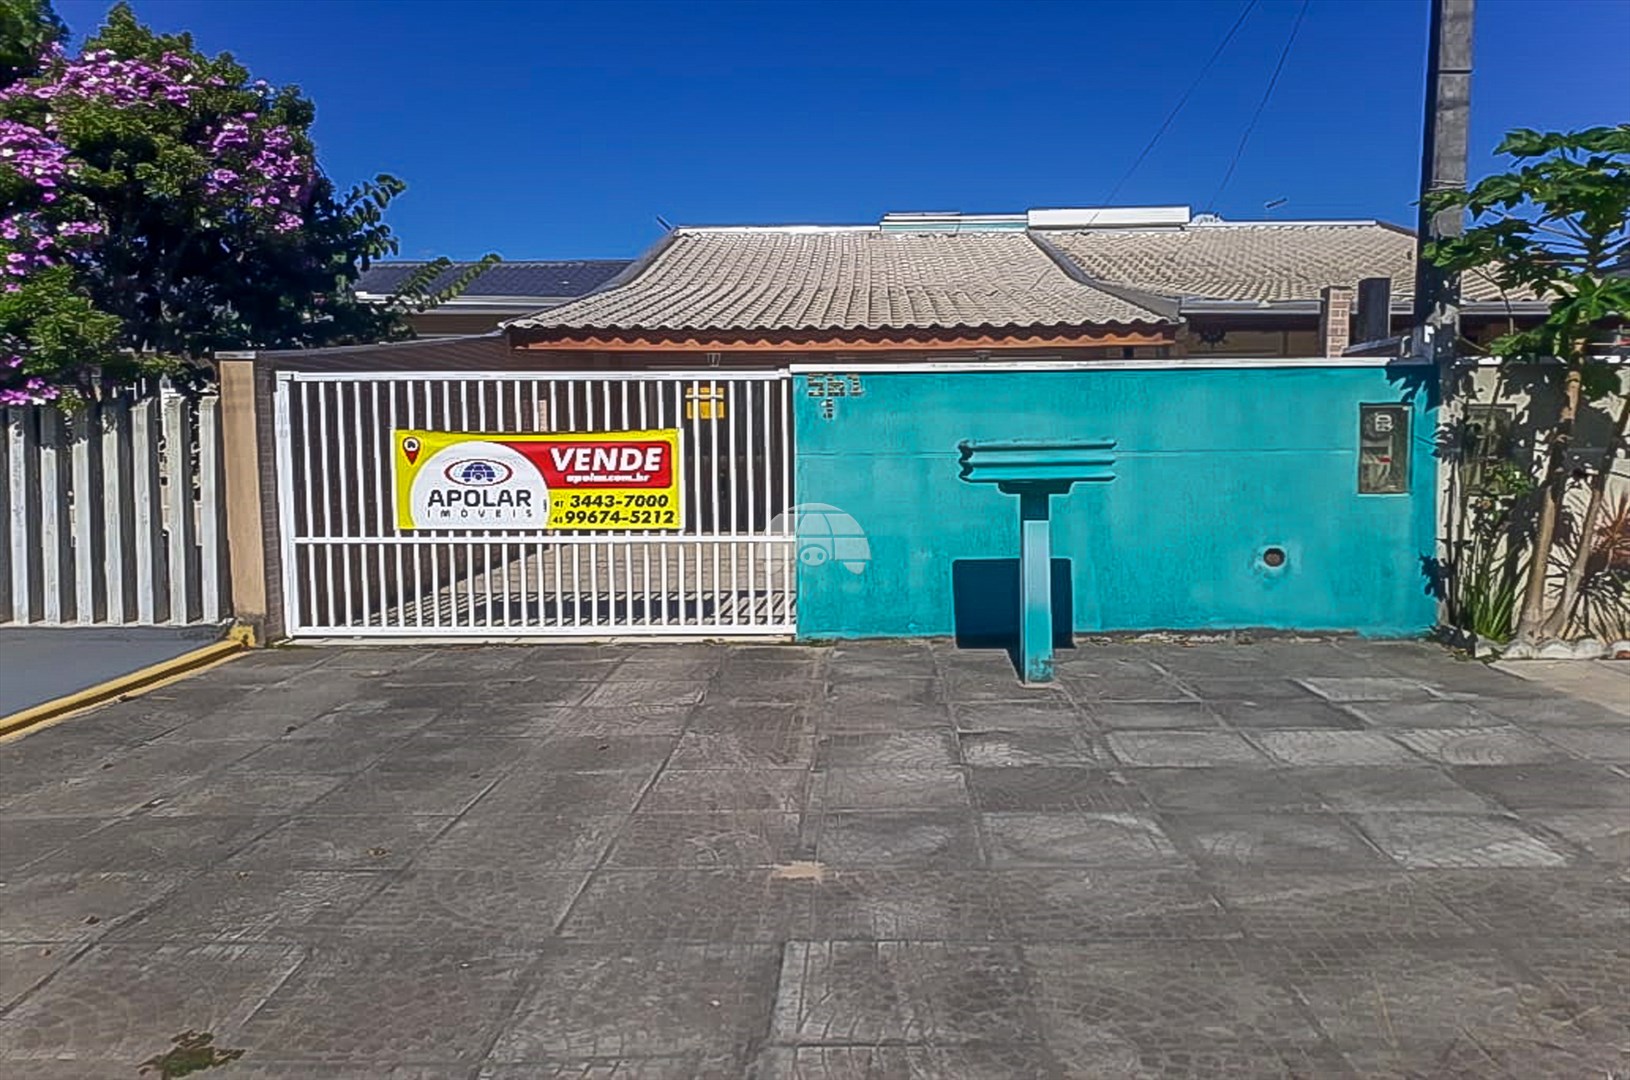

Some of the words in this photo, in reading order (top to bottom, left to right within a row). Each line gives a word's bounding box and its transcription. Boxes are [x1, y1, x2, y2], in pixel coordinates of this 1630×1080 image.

[550, 447, 663, 471] VENDE
[566, 472, 651, 484] apolar.com.br
[428, 489, 532, 507] APOLAR
[570, 494, 669, 508] 3443-7000
[565, 510, 675, 524] 99674-5212
